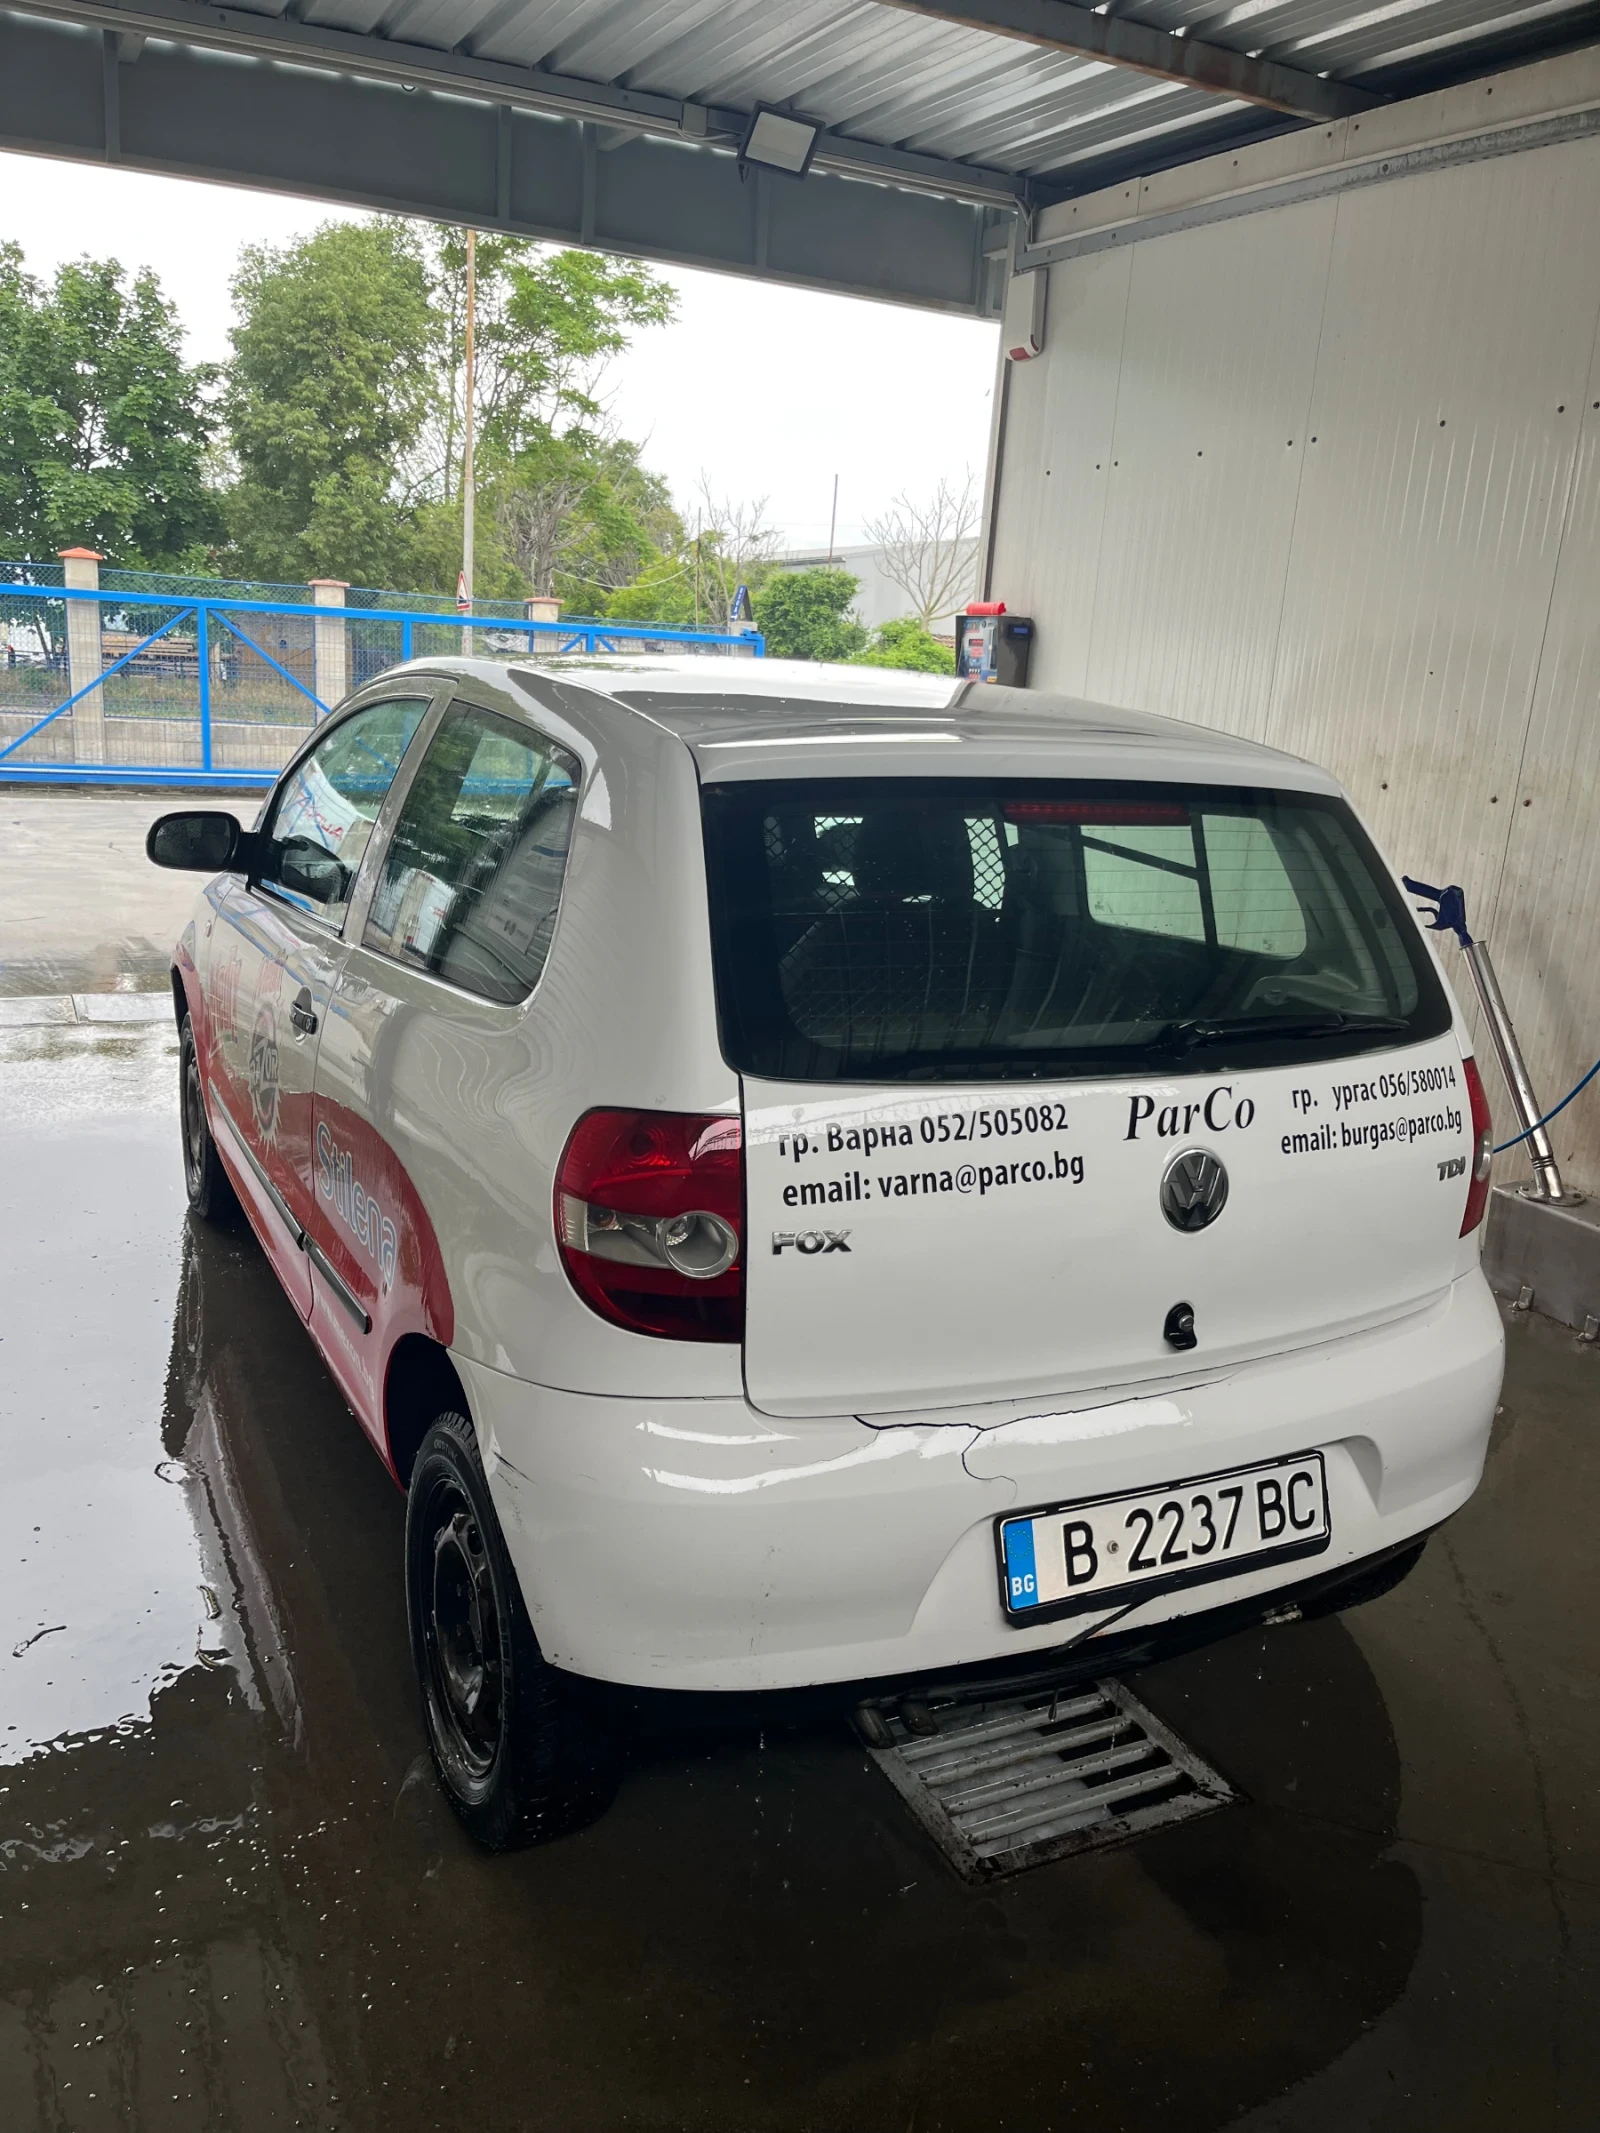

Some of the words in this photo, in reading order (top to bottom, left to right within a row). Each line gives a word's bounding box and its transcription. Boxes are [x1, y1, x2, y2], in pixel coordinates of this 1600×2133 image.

[1122, 1086, 1255, 1141] ParCo
[1292, 1089, 1318, 1115] гр.
[1379, 1065, 1456, 1098] 056/580014
[778, 1132, 818, 1163] гр.
[826, 1122, 914, 1156] Варна
[920, 1103, 1069, 1144] 052/505082
[1281, 1124, 1337, 1154] email:
[1341, 1106, 1462, 1150] burgas@parco.bg
[782, 1171, 871, 1207] email:
[877, 1151, 1085, 1198] varna@parco.bg
[1436, 1156, 1466, 1181] TDI
[317, 1121, 397, 1292] Stilena
[771, 1229, 852, 1255] FOX
[1062, 1520, 1098, 1587] B
[1124, 1485, 1243, 1572] 2237
[1256, 1471, 1315, 1540] BC
[1011, 1574, 1034, 1596] BG
